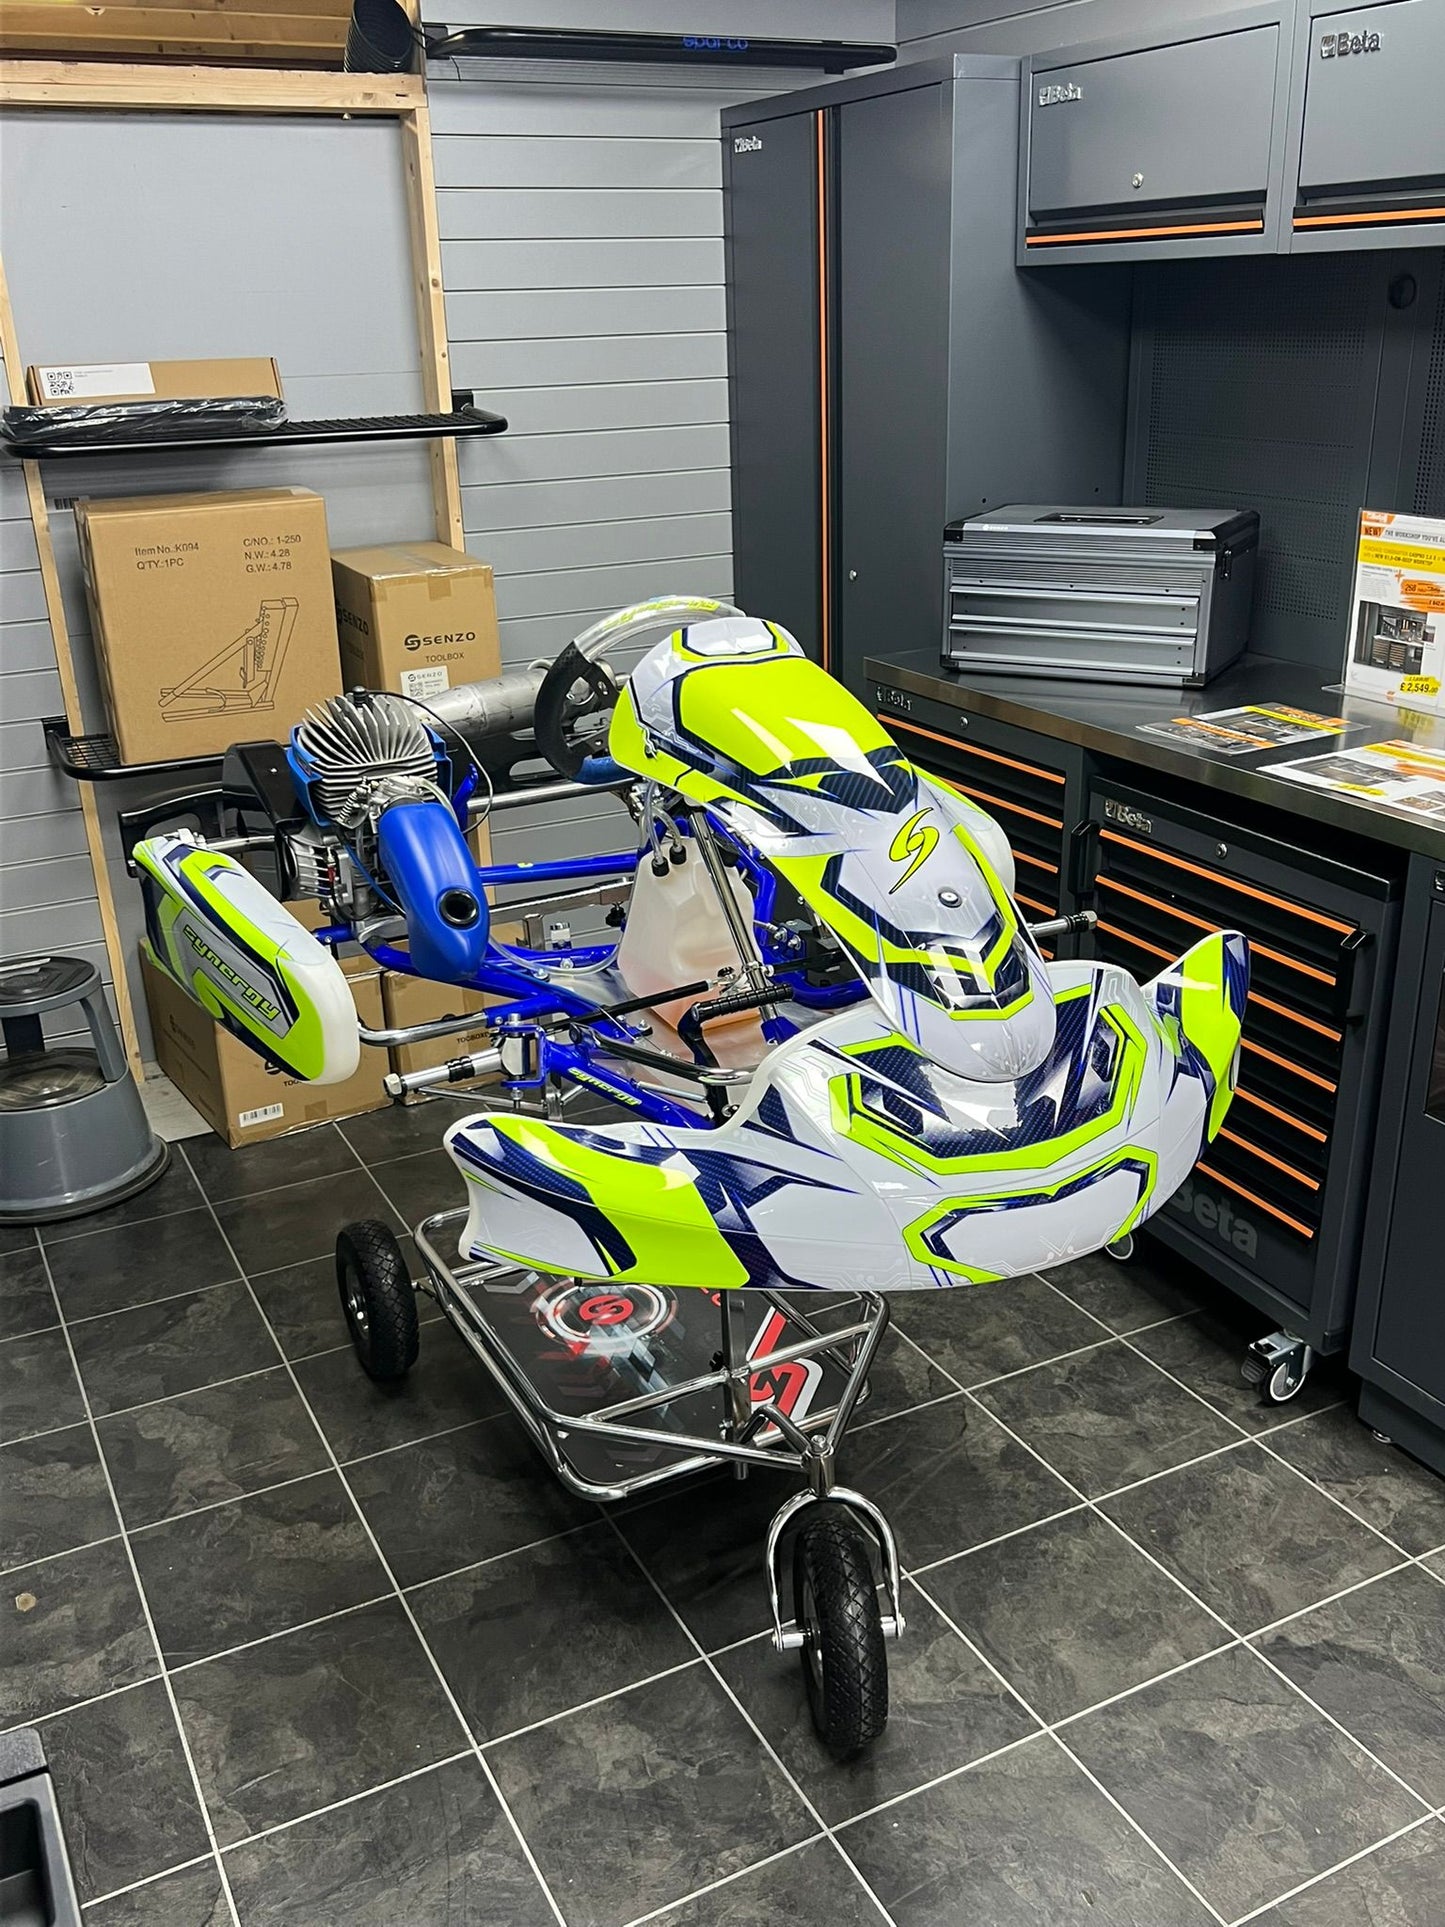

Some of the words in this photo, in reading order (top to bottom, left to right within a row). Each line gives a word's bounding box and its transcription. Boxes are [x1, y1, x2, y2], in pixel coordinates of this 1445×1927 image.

[1338, 30, 1381, 56] Beta
[276, 534, 301, 544] 1-250
[422, 631, 476, 646] SENZO
[425, 651, 465, 663] TOOLBOX
[183, 924, 281, 1021] synergy
[567, 1066, 642, 1106] synergy
